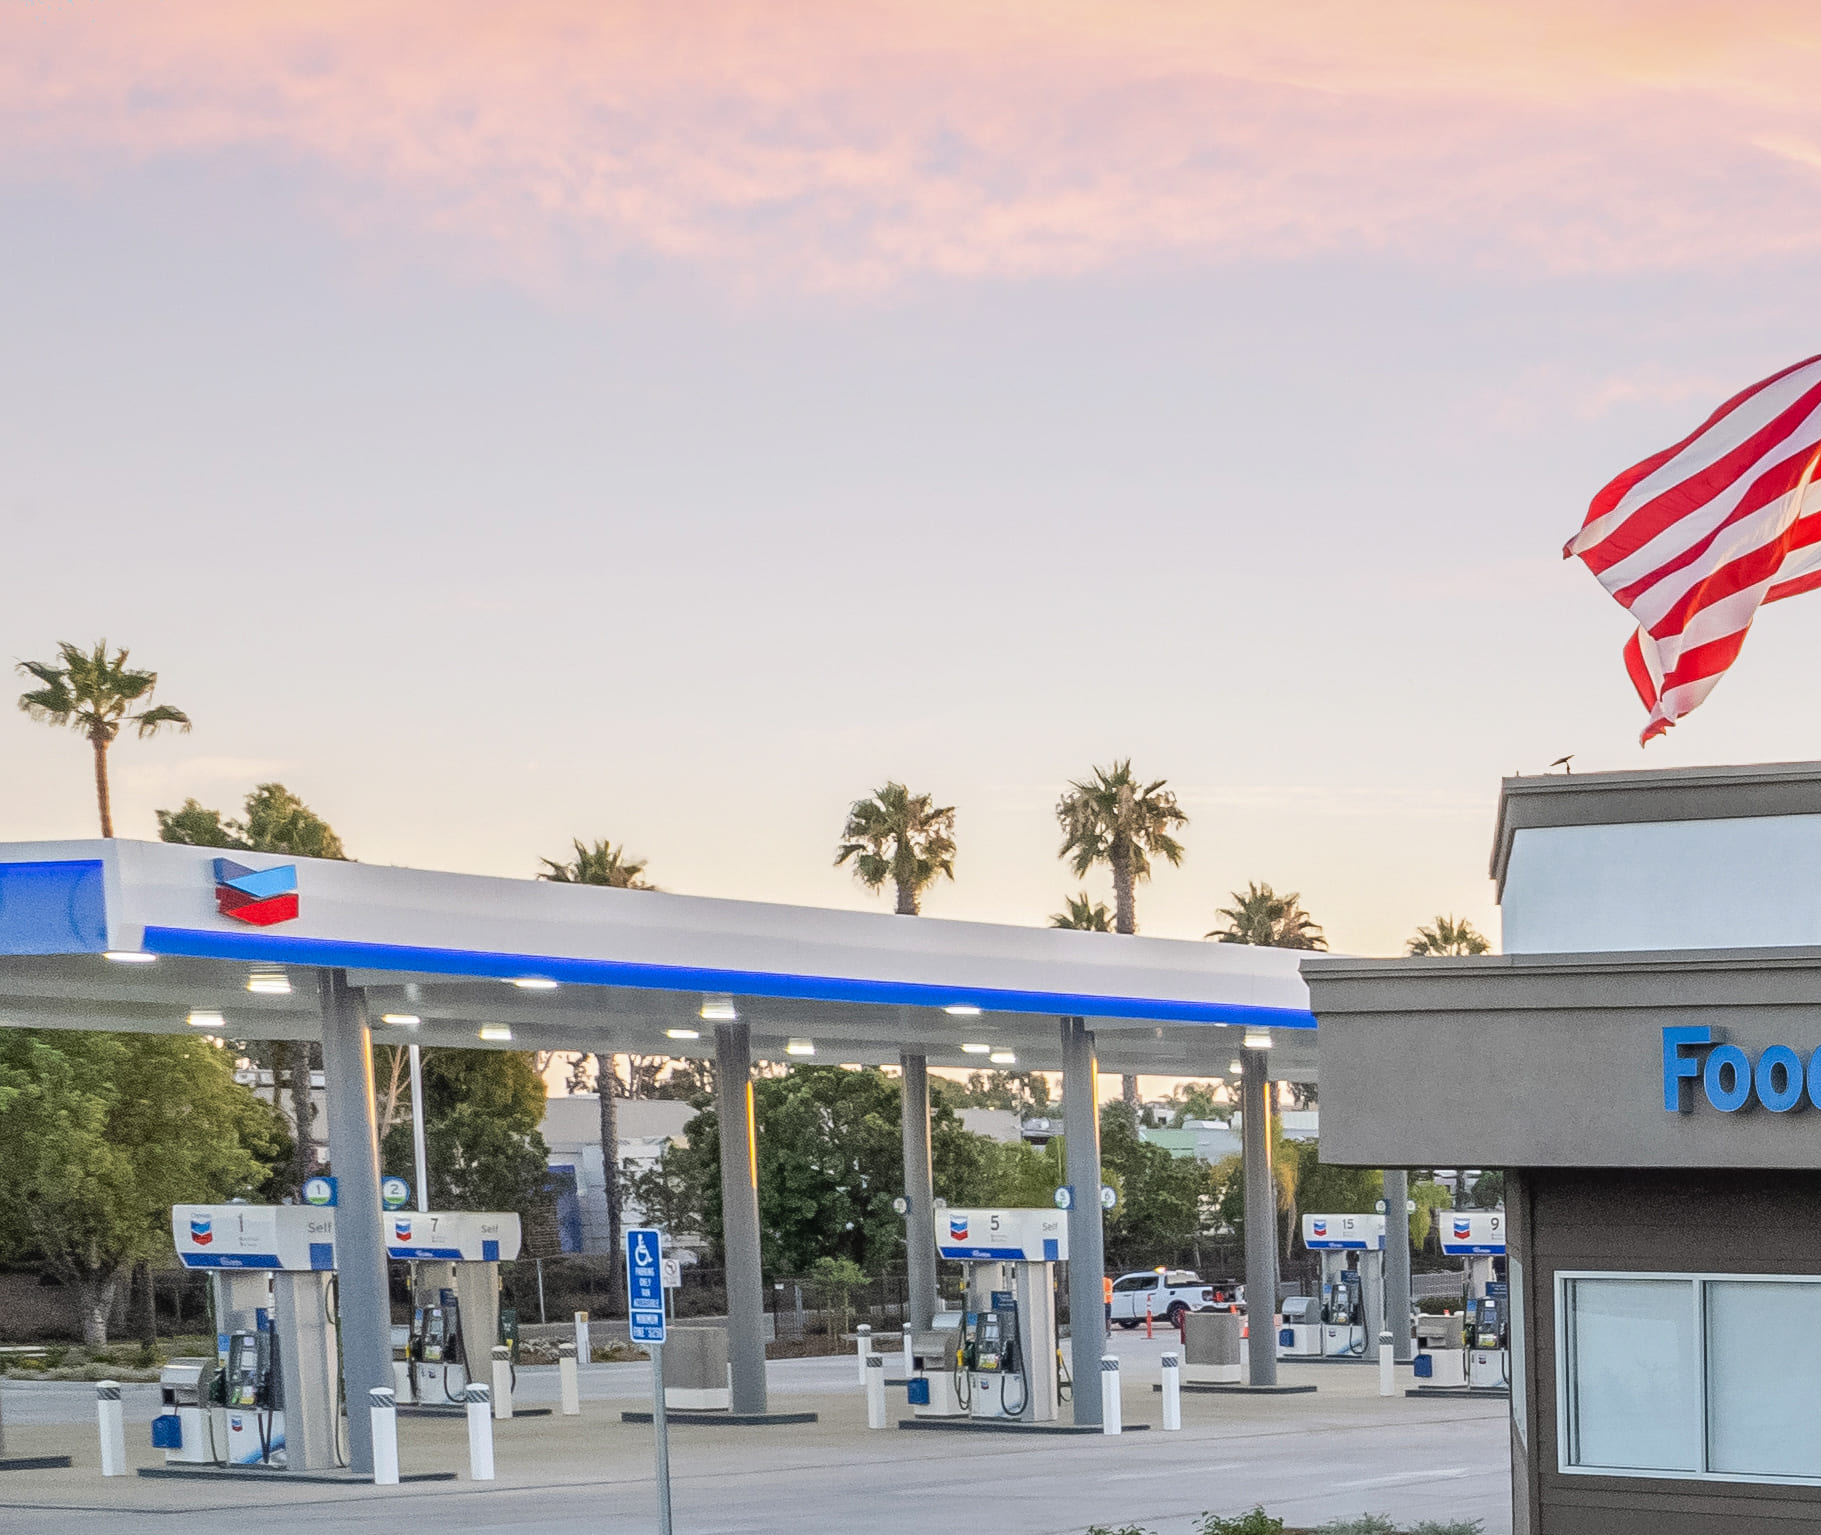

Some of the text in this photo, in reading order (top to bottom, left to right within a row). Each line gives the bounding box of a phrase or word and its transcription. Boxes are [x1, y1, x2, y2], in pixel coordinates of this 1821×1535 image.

[390, 1184, 399, 1194] 2
[237, 1214, 245, 1232] 1
[308, 1222, 332, 1234] Self
[430, 1218, 438, 1232] 7
[481, 1224, 499, 1234] Self
[990, 1215, 1000, 1231] 5
[1042, 1222, 1058, 1232] Self
[1342, 1218, 1355, 1230] 15
[1490, 1217, 1500, 1231] 9
